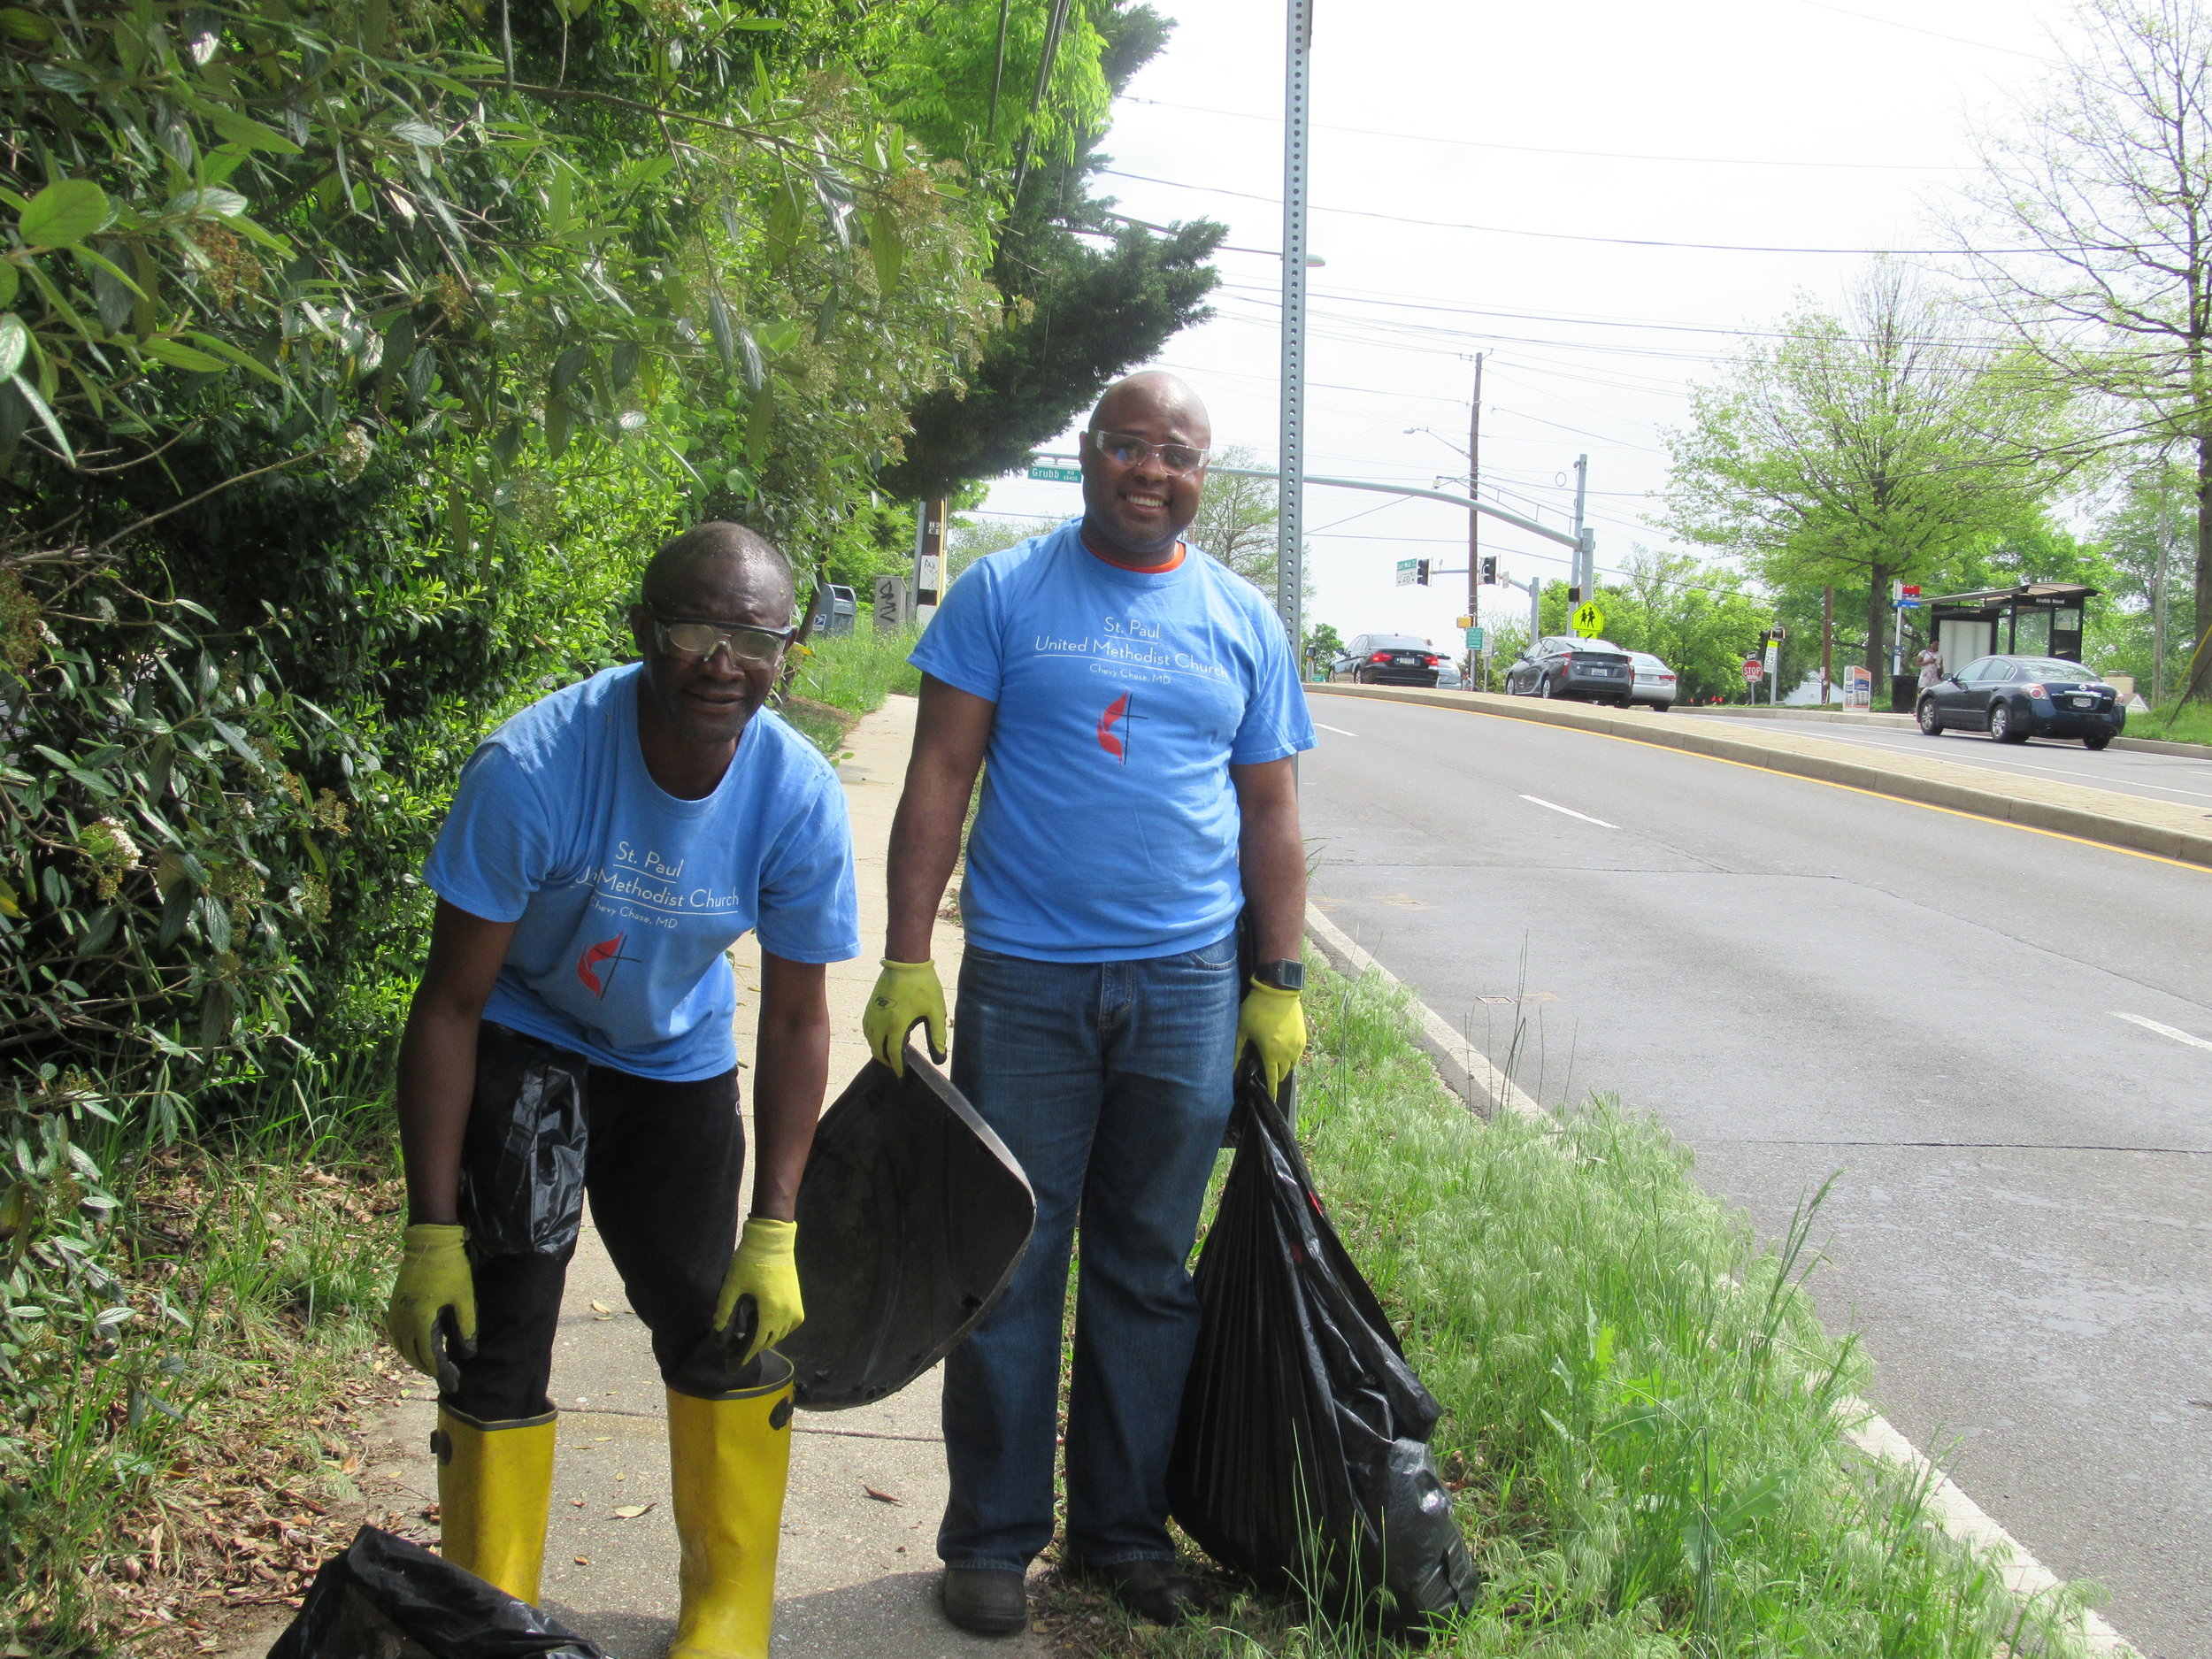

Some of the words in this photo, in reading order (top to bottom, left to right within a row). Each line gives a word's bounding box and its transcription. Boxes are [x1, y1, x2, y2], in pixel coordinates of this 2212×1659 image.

[1032, 468, 1059, 479] Grubb
[1104, 617, 1124, 634] St.
[1130, 619, 1160, 639] Paul
[1035, 635, 1088, 652] United
[1093, 639, 1170, 666] Methodist
[1175, 653, 1228, 680] Church
[1765, 656, 1774, 664] 25
[1089, 664, 1118, 678] Chevy
[1152, 674, 1171, 685] MD
[1744, 666, 1762, 675] STOP
[616, 841, 638, 864] St.
[644, 851, 684, 878] Paul
[596, 868, 684, 907] Methodist
[690, 886, 739, 908] Church
[590, 896, 617, 916] Chevy
[656, 917, 678, 928] MD
